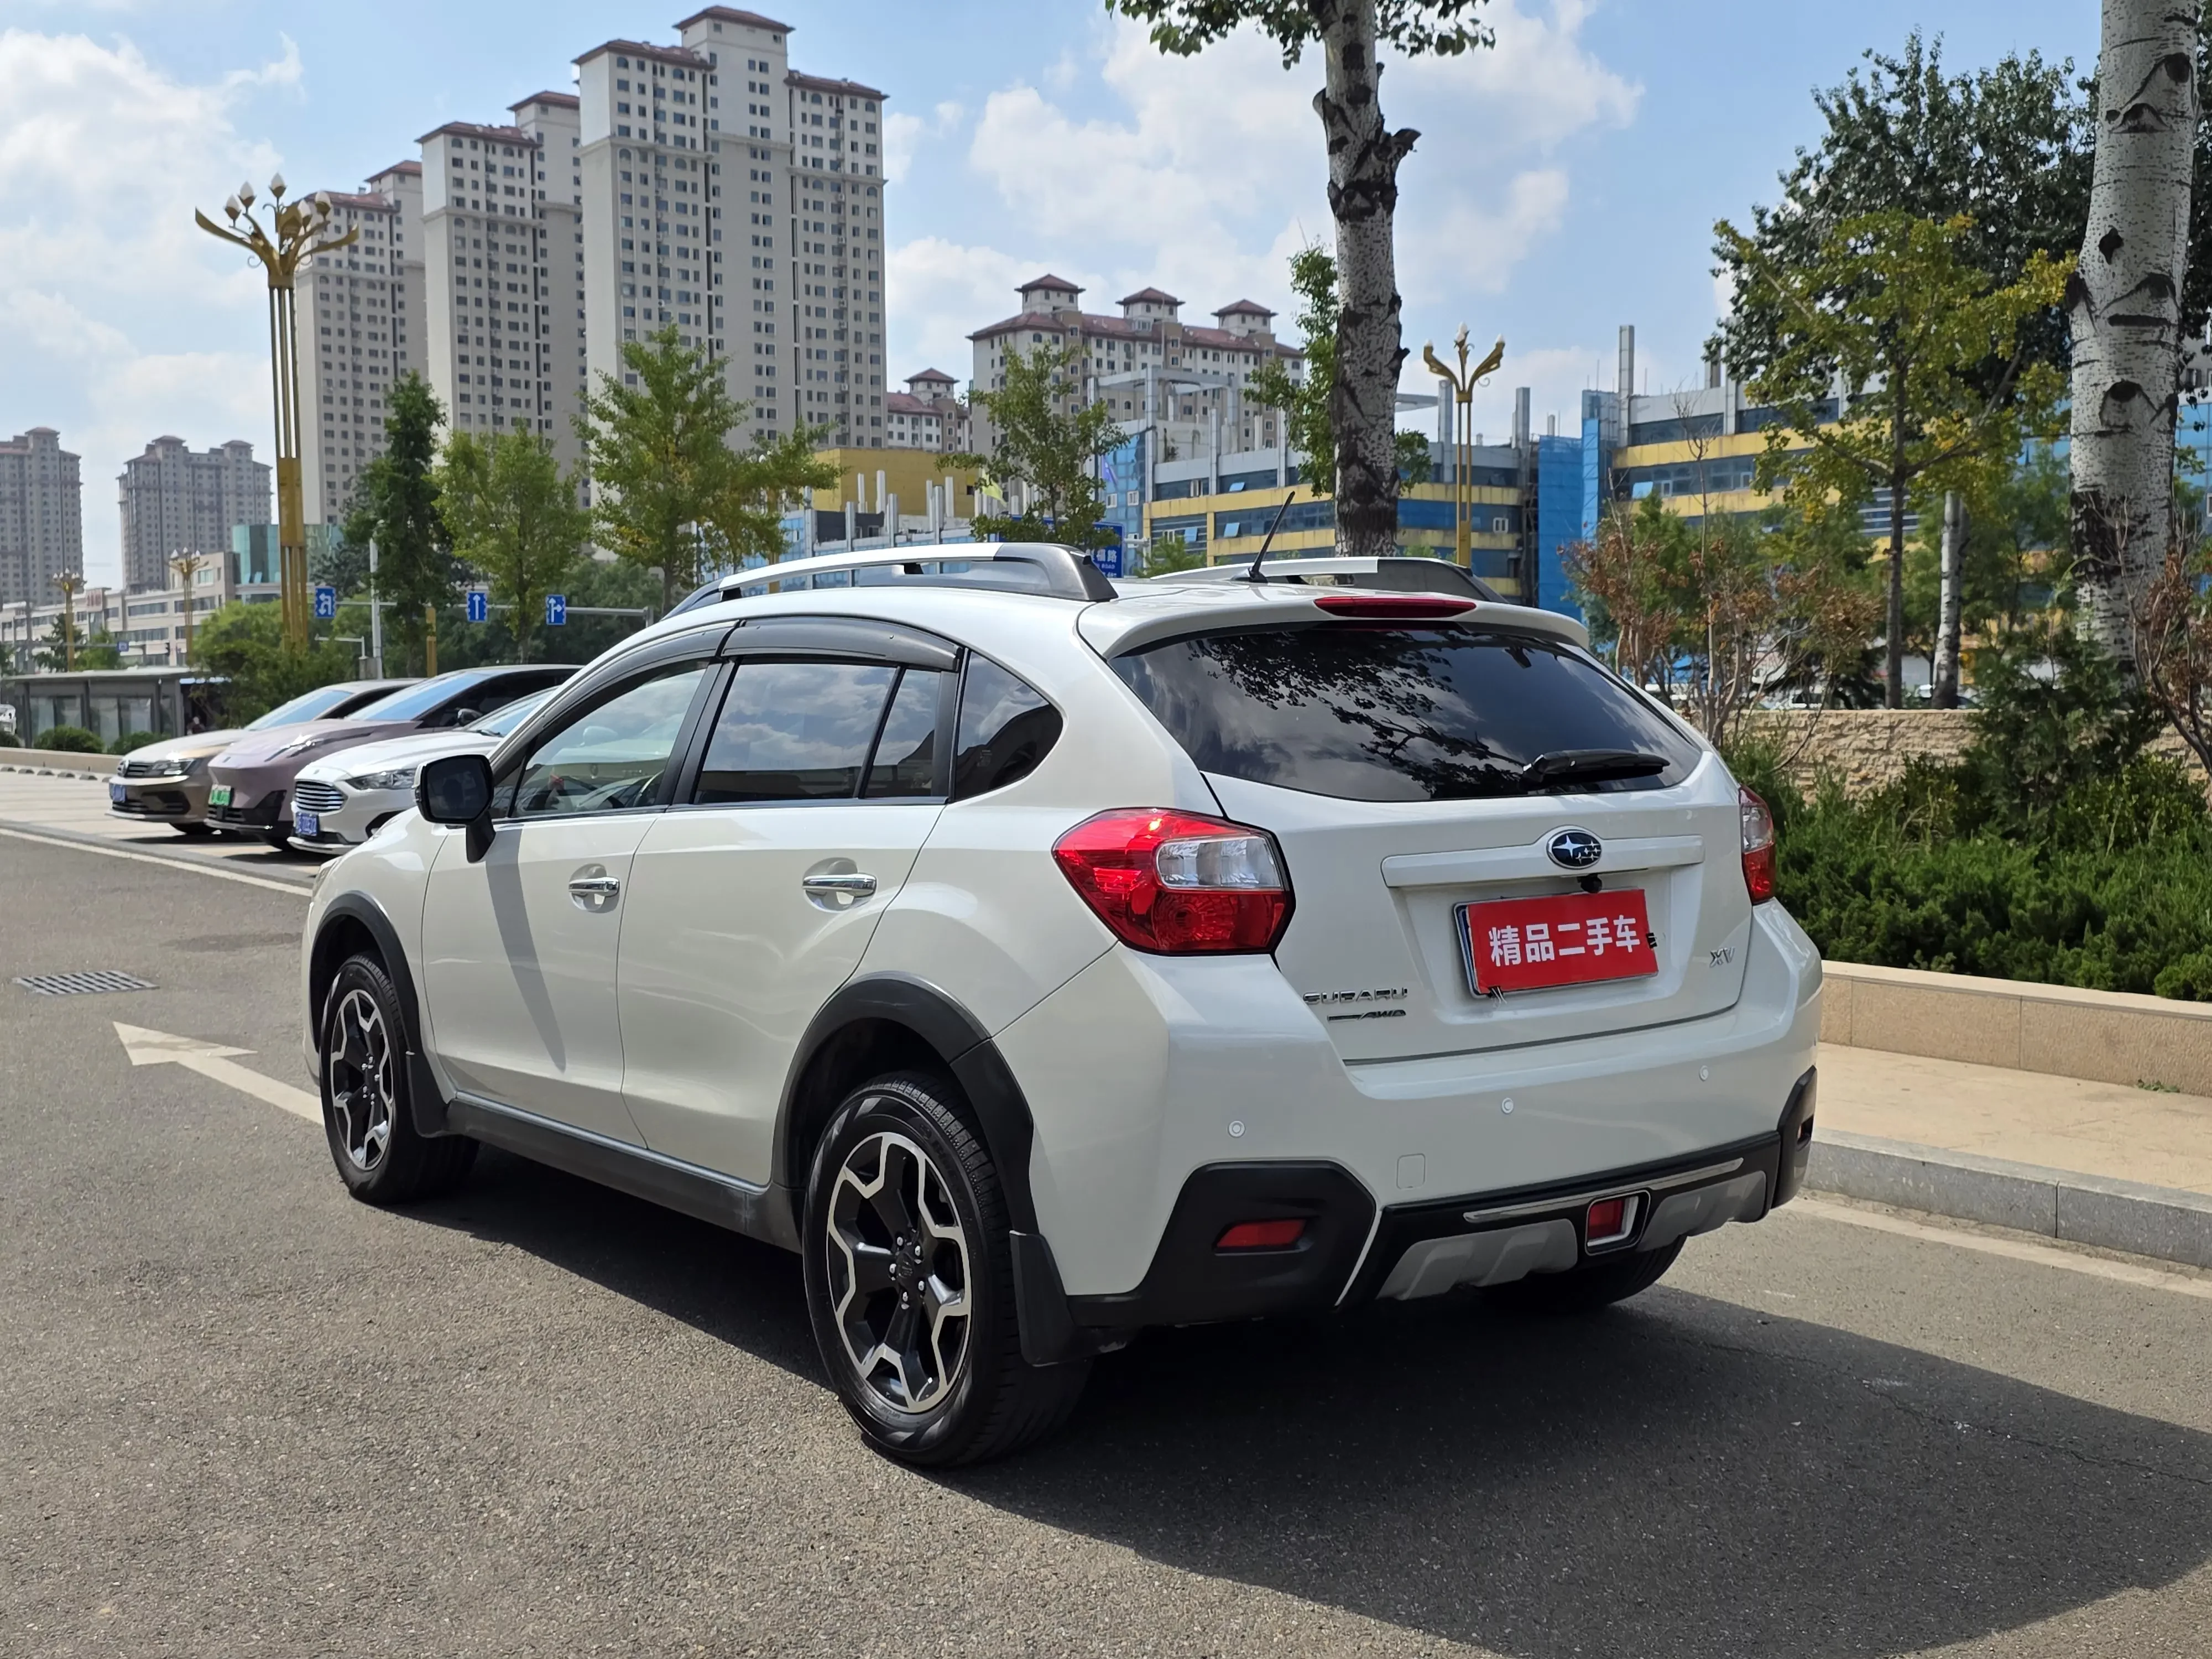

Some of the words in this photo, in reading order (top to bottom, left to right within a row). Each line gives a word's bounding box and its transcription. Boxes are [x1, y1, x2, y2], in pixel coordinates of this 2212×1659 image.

[1488, 915, 1641, 967] 精品二手车
[1709, 946, 1736, 968] XV
[1303, 987, 1408, 1004] SUBARU
[1359, 1009, 1406, 1020] AWD
